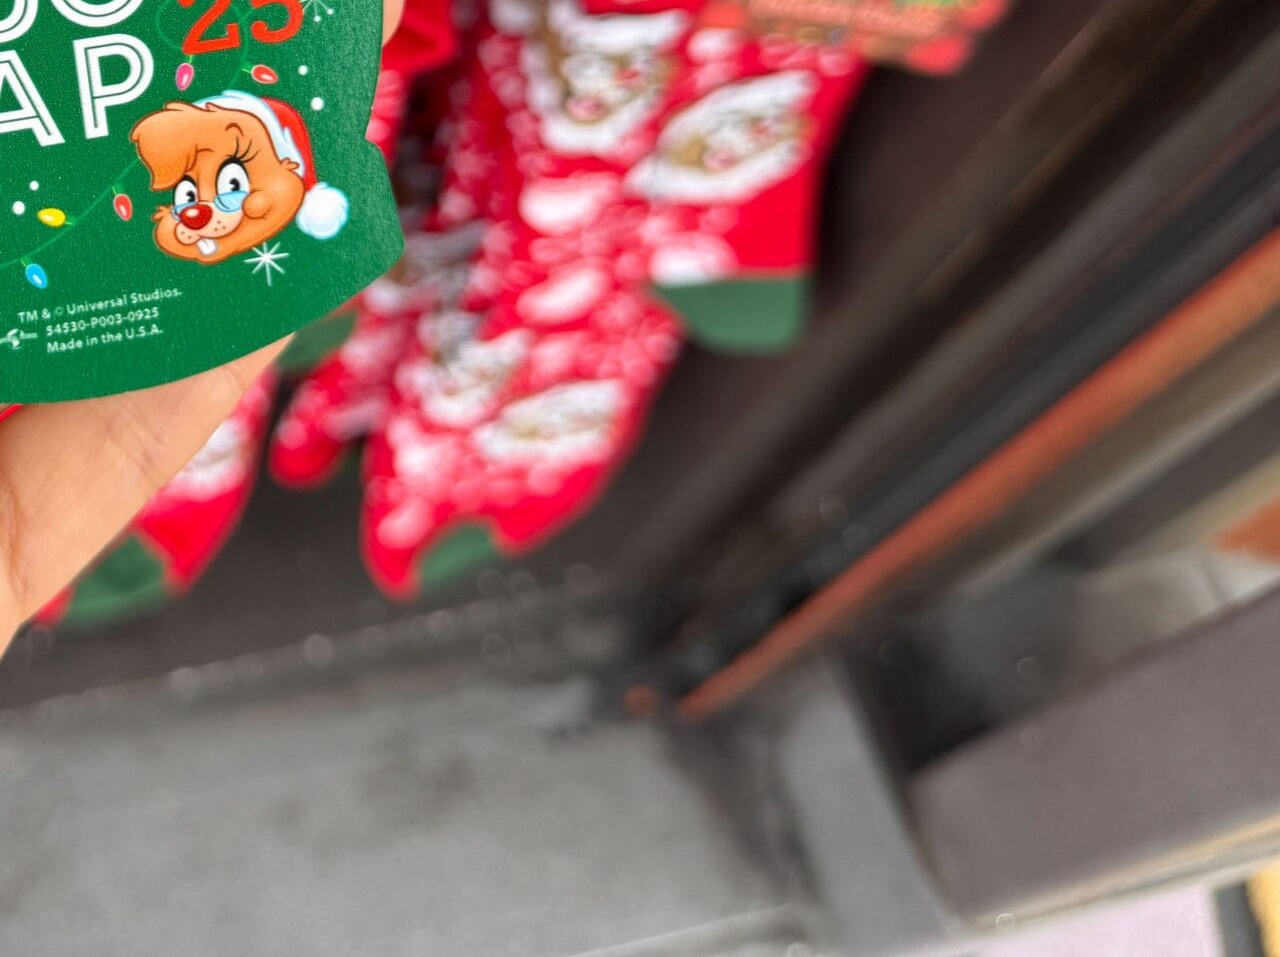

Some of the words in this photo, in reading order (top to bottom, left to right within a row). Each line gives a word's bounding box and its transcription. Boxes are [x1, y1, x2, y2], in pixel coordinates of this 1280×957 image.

[17, 310, 38, 323] TM
[41, 308, 51, 319] &
[66, 294, 128, 315] Universal
[131, 287, 182, 303] Studios.
[46, 307, 159, 337] 54530-P003-0925
[47, 337, 83, 354] Made
[86, 335, 98, 347] in
[101, 330, 123, 345] the
[125, 323, 164, 339] U.S.A.
